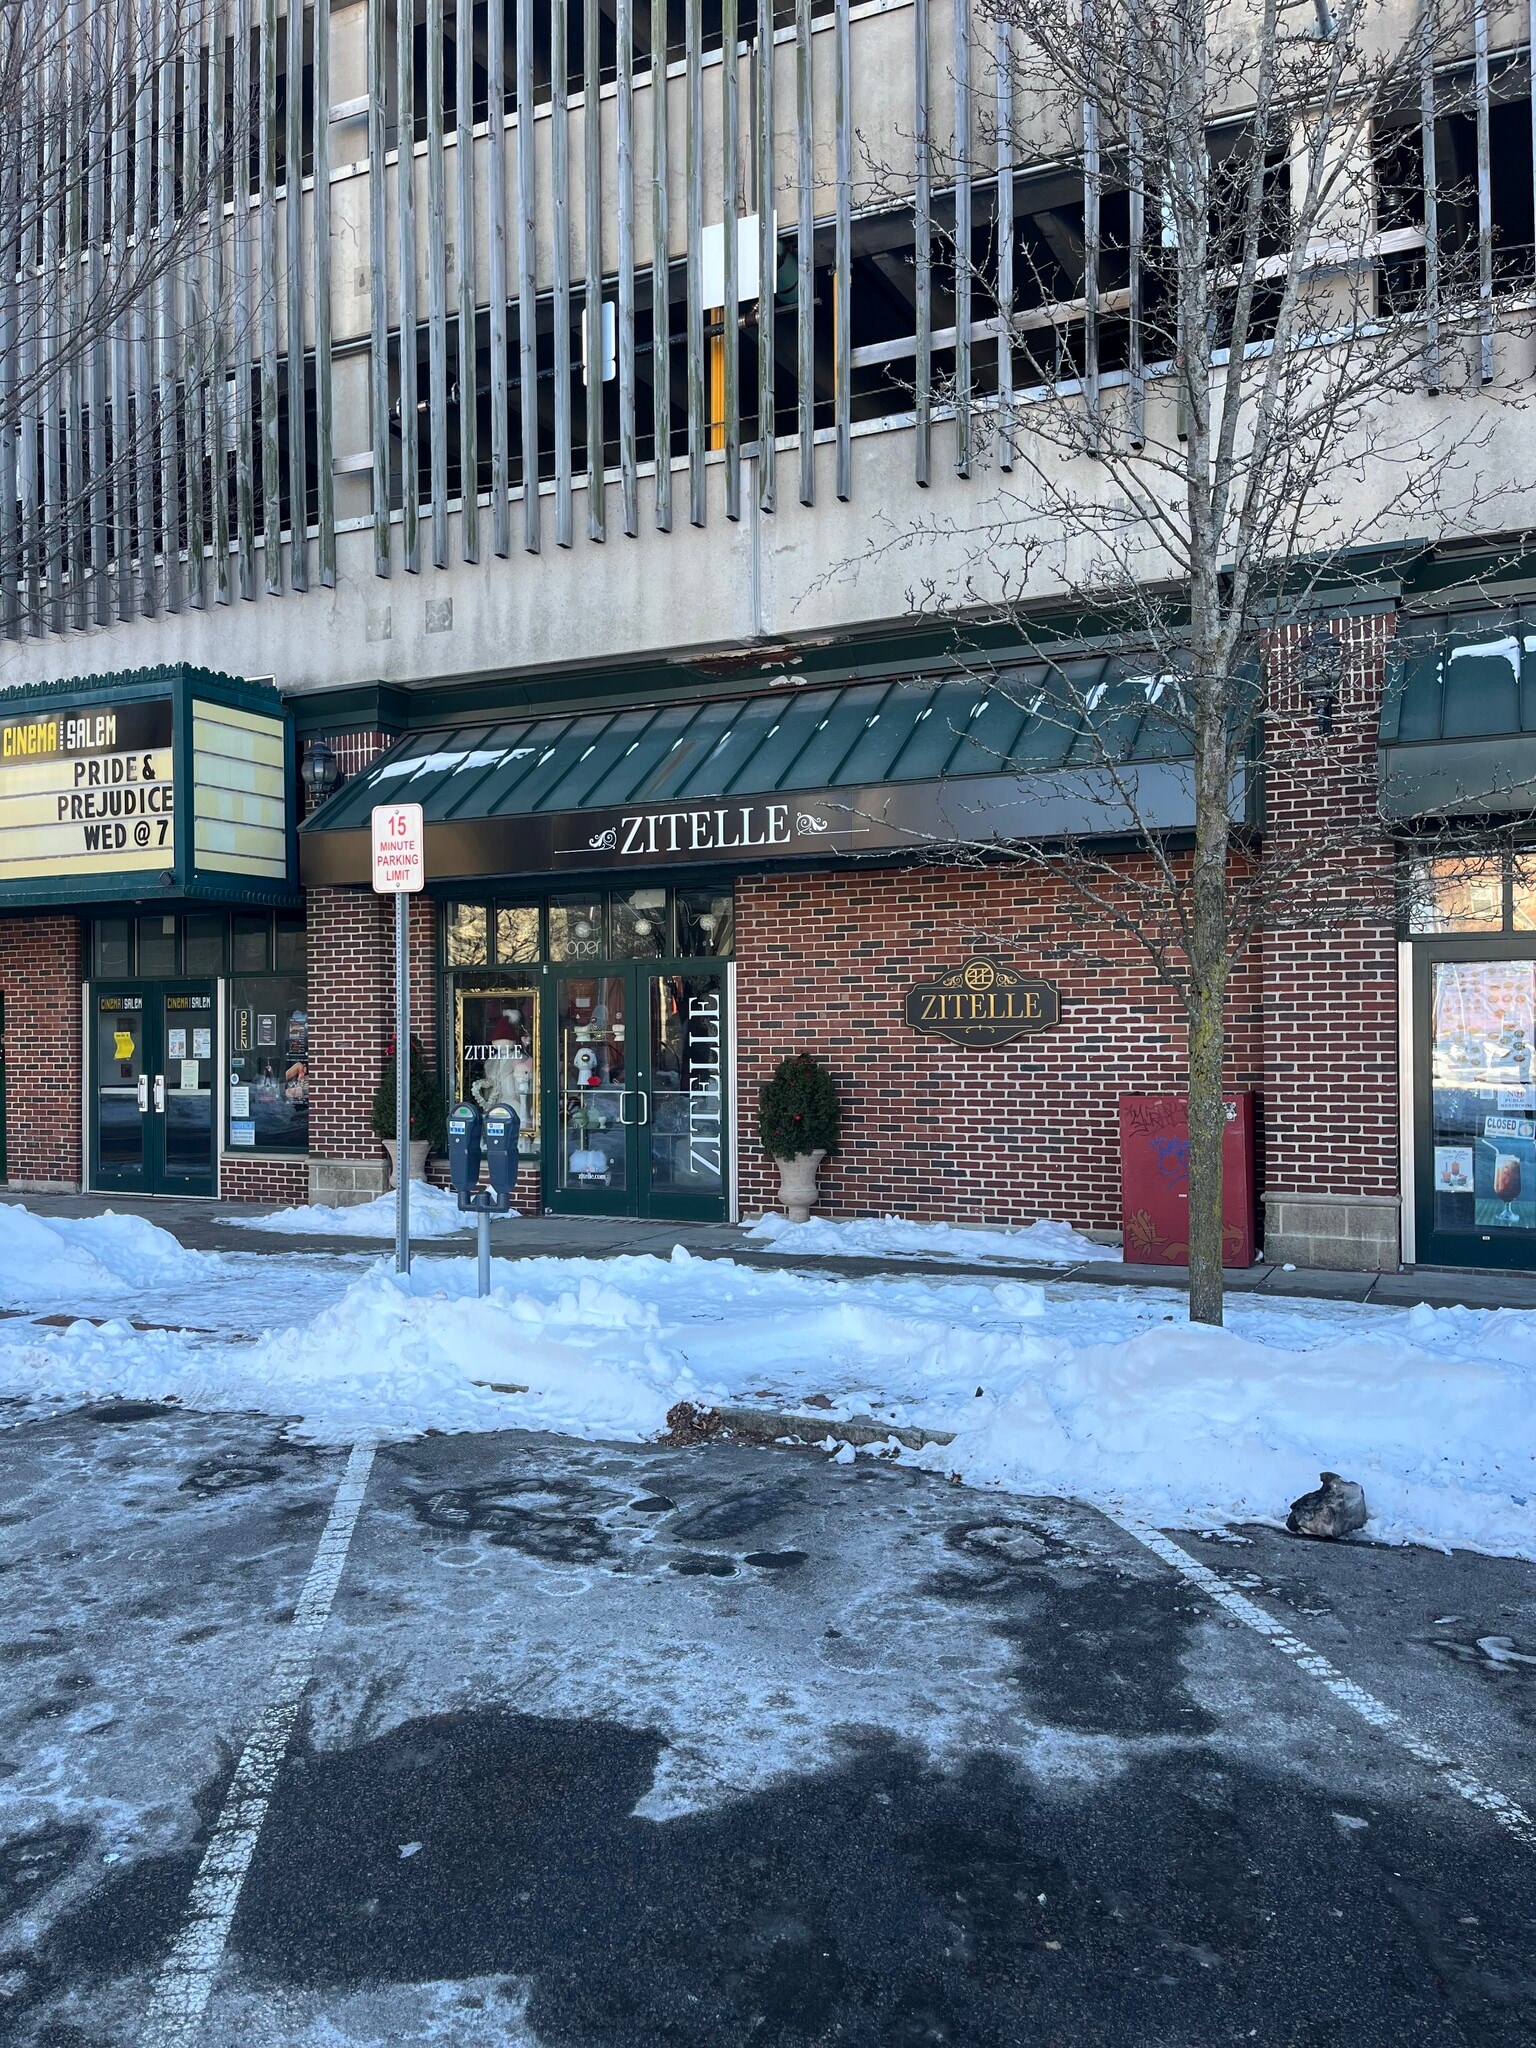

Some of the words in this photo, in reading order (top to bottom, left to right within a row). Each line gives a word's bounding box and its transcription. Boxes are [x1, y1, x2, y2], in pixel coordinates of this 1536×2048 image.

[74, 756, 138, 787] PRIDE
[142, 754, 156, 780] &
[57, 786, 173, 821] PREJUDICE
[84, 822, 127, 851] WED
[134, 820, 151, 847] @
[157, 819, 169, 845] 7
[388, 815, 407, 836] 15
[621, 805, 791, 854] ZITELLE
[377, 854, 418, 866] PARKING
[380, 841, 415, 851] MINUTE
[386, 870, 410, 880] LIMIT
[921, 992, 1042, 1020] ZITELLE
[240, 1010, 248, 1049] OPEN
[464, 1044, 523, 1061] ZITELLE
[688, 994, 721, 1176] ZITELLE
[1487, 1117, 1517, 1130] CLOSED
